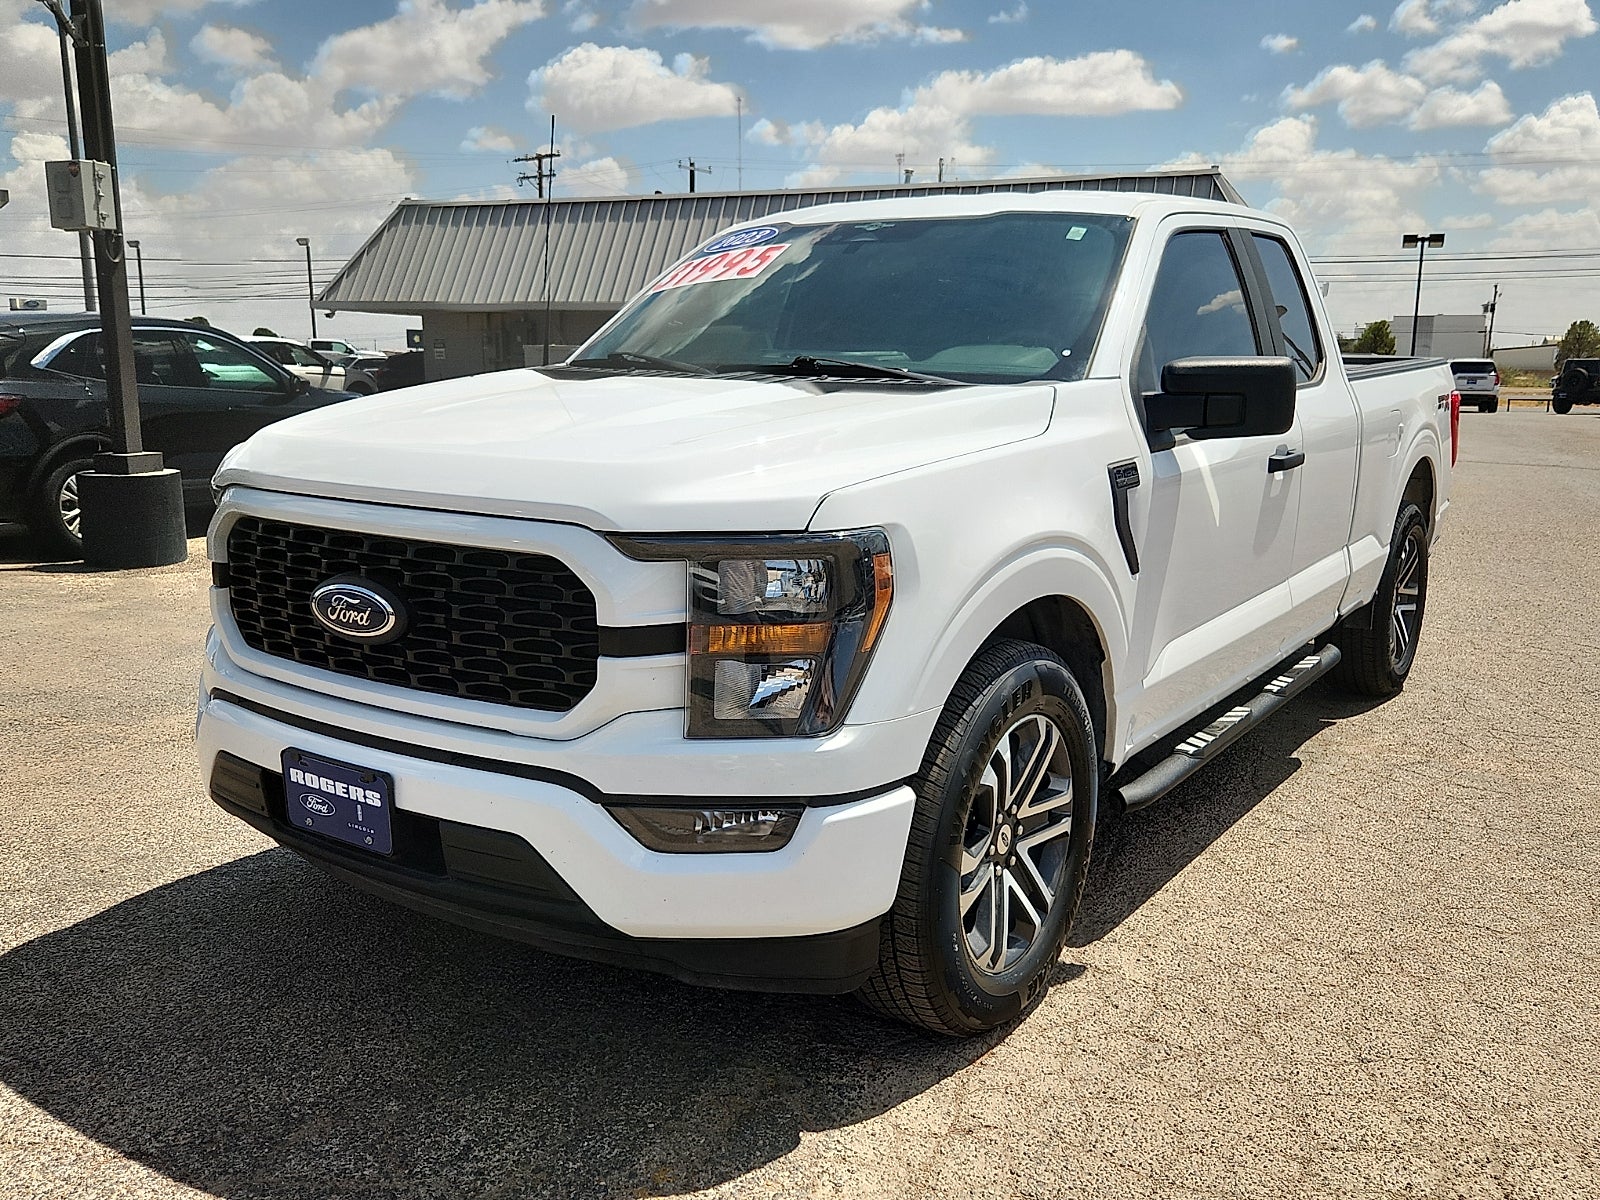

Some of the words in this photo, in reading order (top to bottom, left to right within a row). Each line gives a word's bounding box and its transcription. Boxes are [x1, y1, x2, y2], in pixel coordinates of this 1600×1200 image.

[711, 229, 770, 250] 2023
[328, 594, 372, 626] Ford
[289, 767, 382, 808] ROGERS
[306, 795, 329, 813] Ford
[347, 822, 375, 834] LINCOLN
